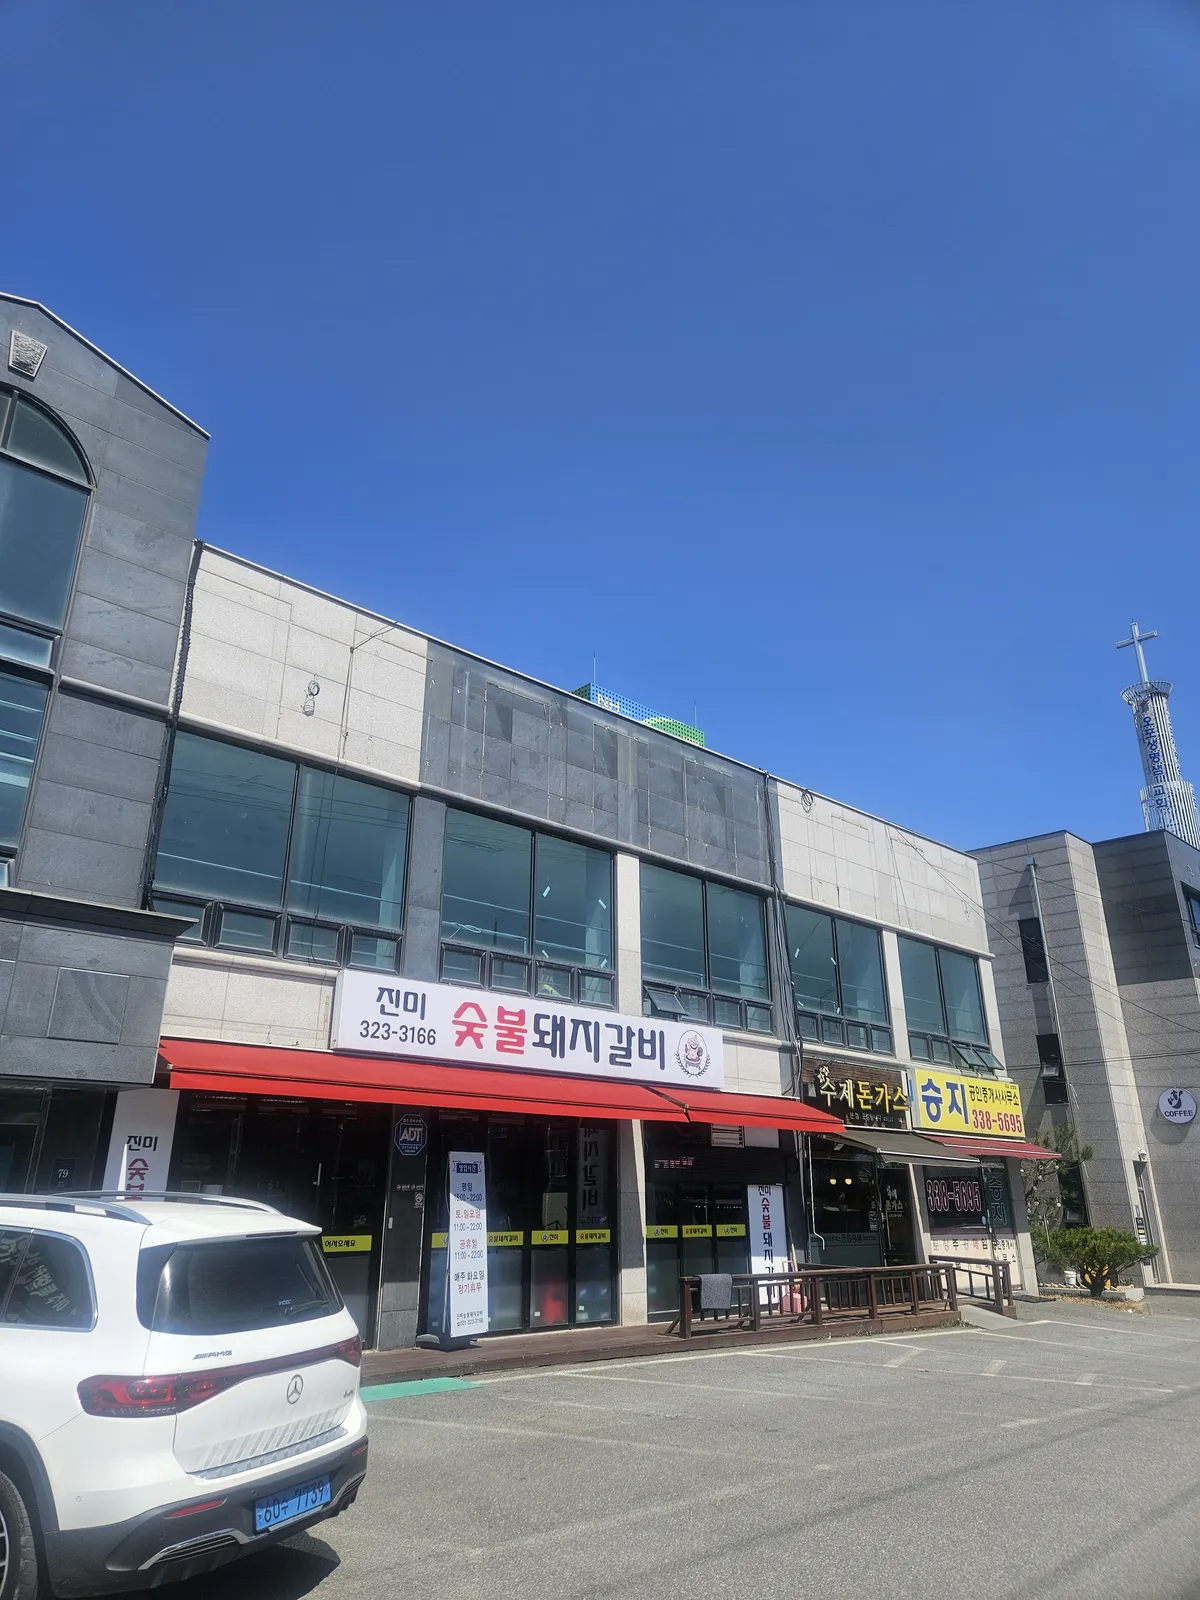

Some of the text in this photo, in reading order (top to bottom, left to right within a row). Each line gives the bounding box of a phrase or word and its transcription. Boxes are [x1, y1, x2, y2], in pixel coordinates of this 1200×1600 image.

[376, 987, 426, 1020] 진미
[359, 1020, 436, 1046] 323-3166
[452, 1001, 665, 1071] 숯불돼지갈비
[820, 1077, 909, 1113] 수제돈가스
[921, 1078, 969, 1125] 승지
[969, 1084, 1019, 1106] 공인중개사사무소
[972, 1109, 1022, 1133] 338-5695
[400, 1127, 422, 1141] ADT
[126, 1135, 158, 1151] 진미
[58, 1169, 69, 1178] 79
[459, 1164, 477, 1173] 영업시간
[461, 1182, 473, 1192] 평일
[758, 1185, 772, 1196] 진미
[927, 1180, 982, 1212] 338-5695
[454, 1223, 466, 1231] 11:00
[470, 1222, 483, 1231] 22:00
[324, 1239, 356, 1247] 어서오세요
[459, 1239, 478, 1249] 공휴일
[454, 1251, 467, 1260] 11:00
[471, 1250, 484, 1259] 22:00
[454, 1269, 485, 1281] 매주 화요일
[457, 1282, 482, 1295] 정기휴무
[264, 1480, 324, 1523] 60수 7739
